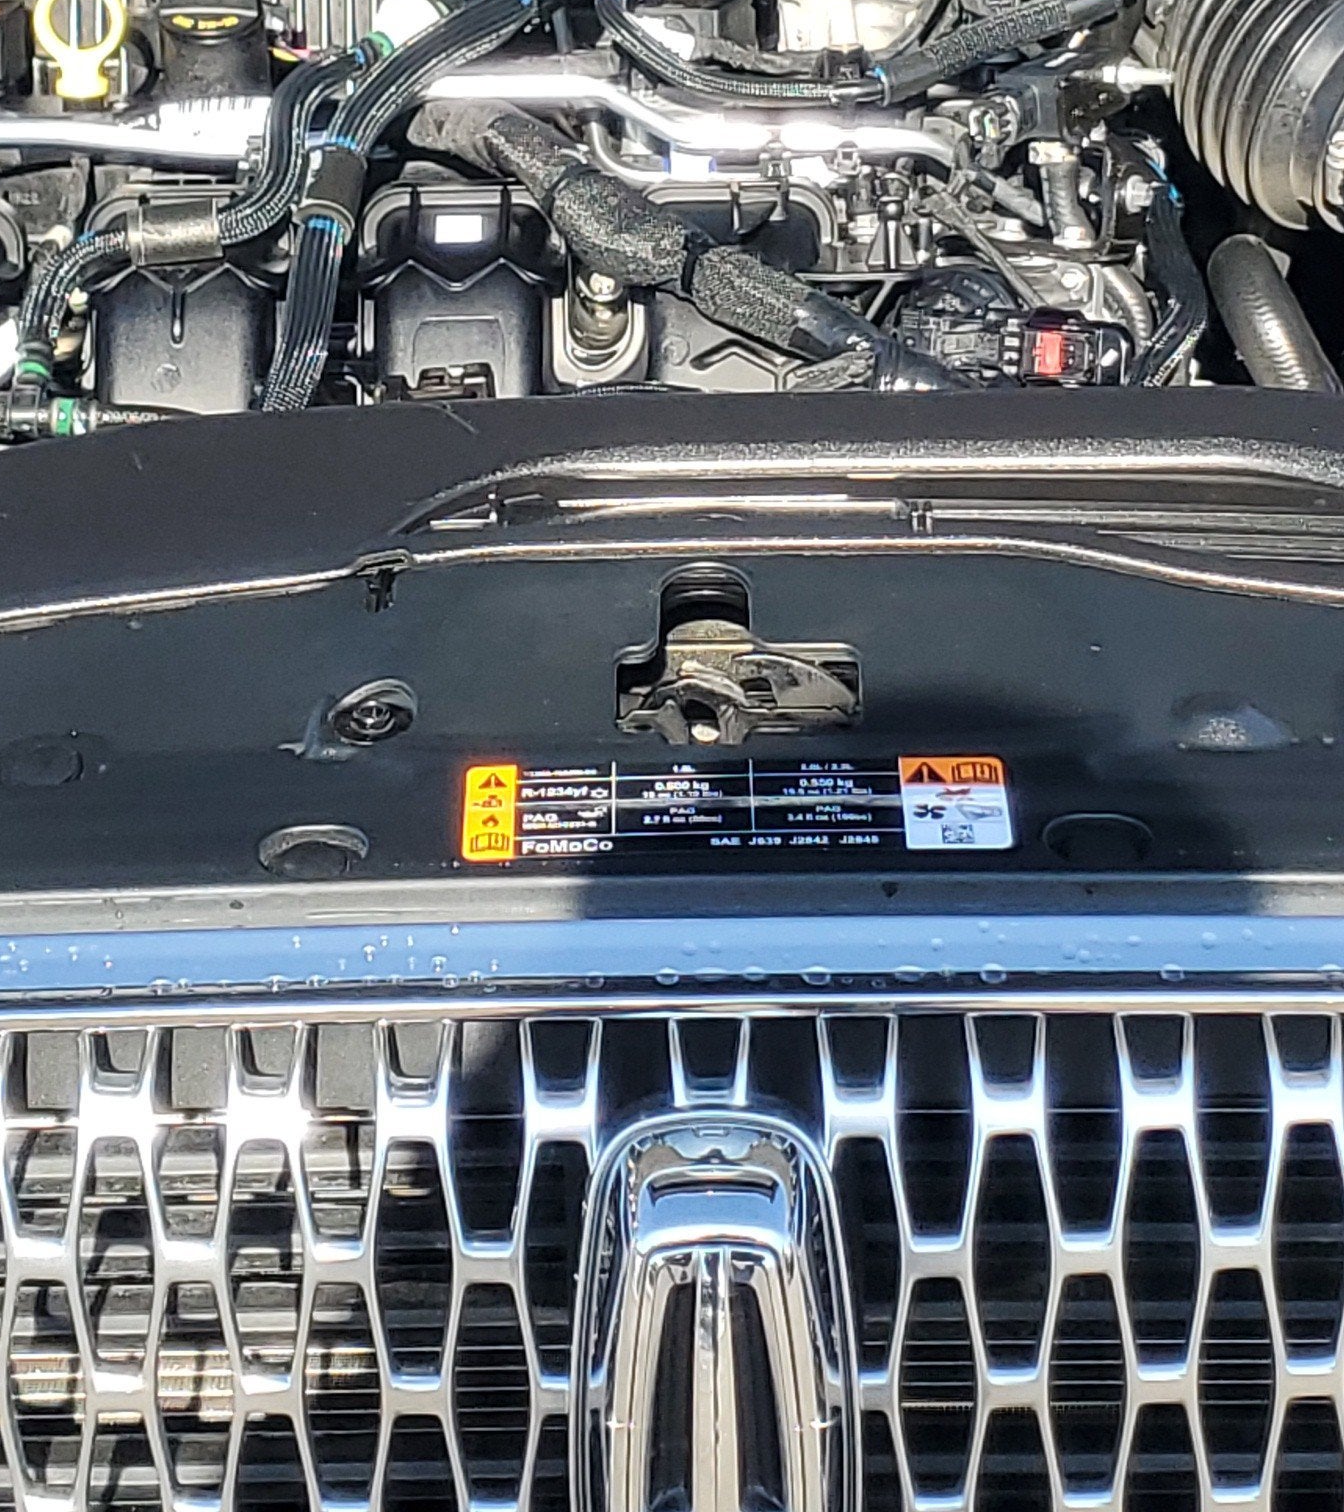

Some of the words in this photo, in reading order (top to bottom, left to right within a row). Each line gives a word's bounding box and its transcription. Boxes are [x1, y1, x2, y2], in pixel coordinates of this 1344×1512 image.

[692, 780, 710, 791] kg
[836, 777, 854, 788] kg
[521, 785, 589, 799] R-1234yf
[522, 813, 558, 823] PAG
[521, 838, 614, 855] FoMoCo
[710, 836, 742, 846] SAE
[748, 836, 782, 846] J639
